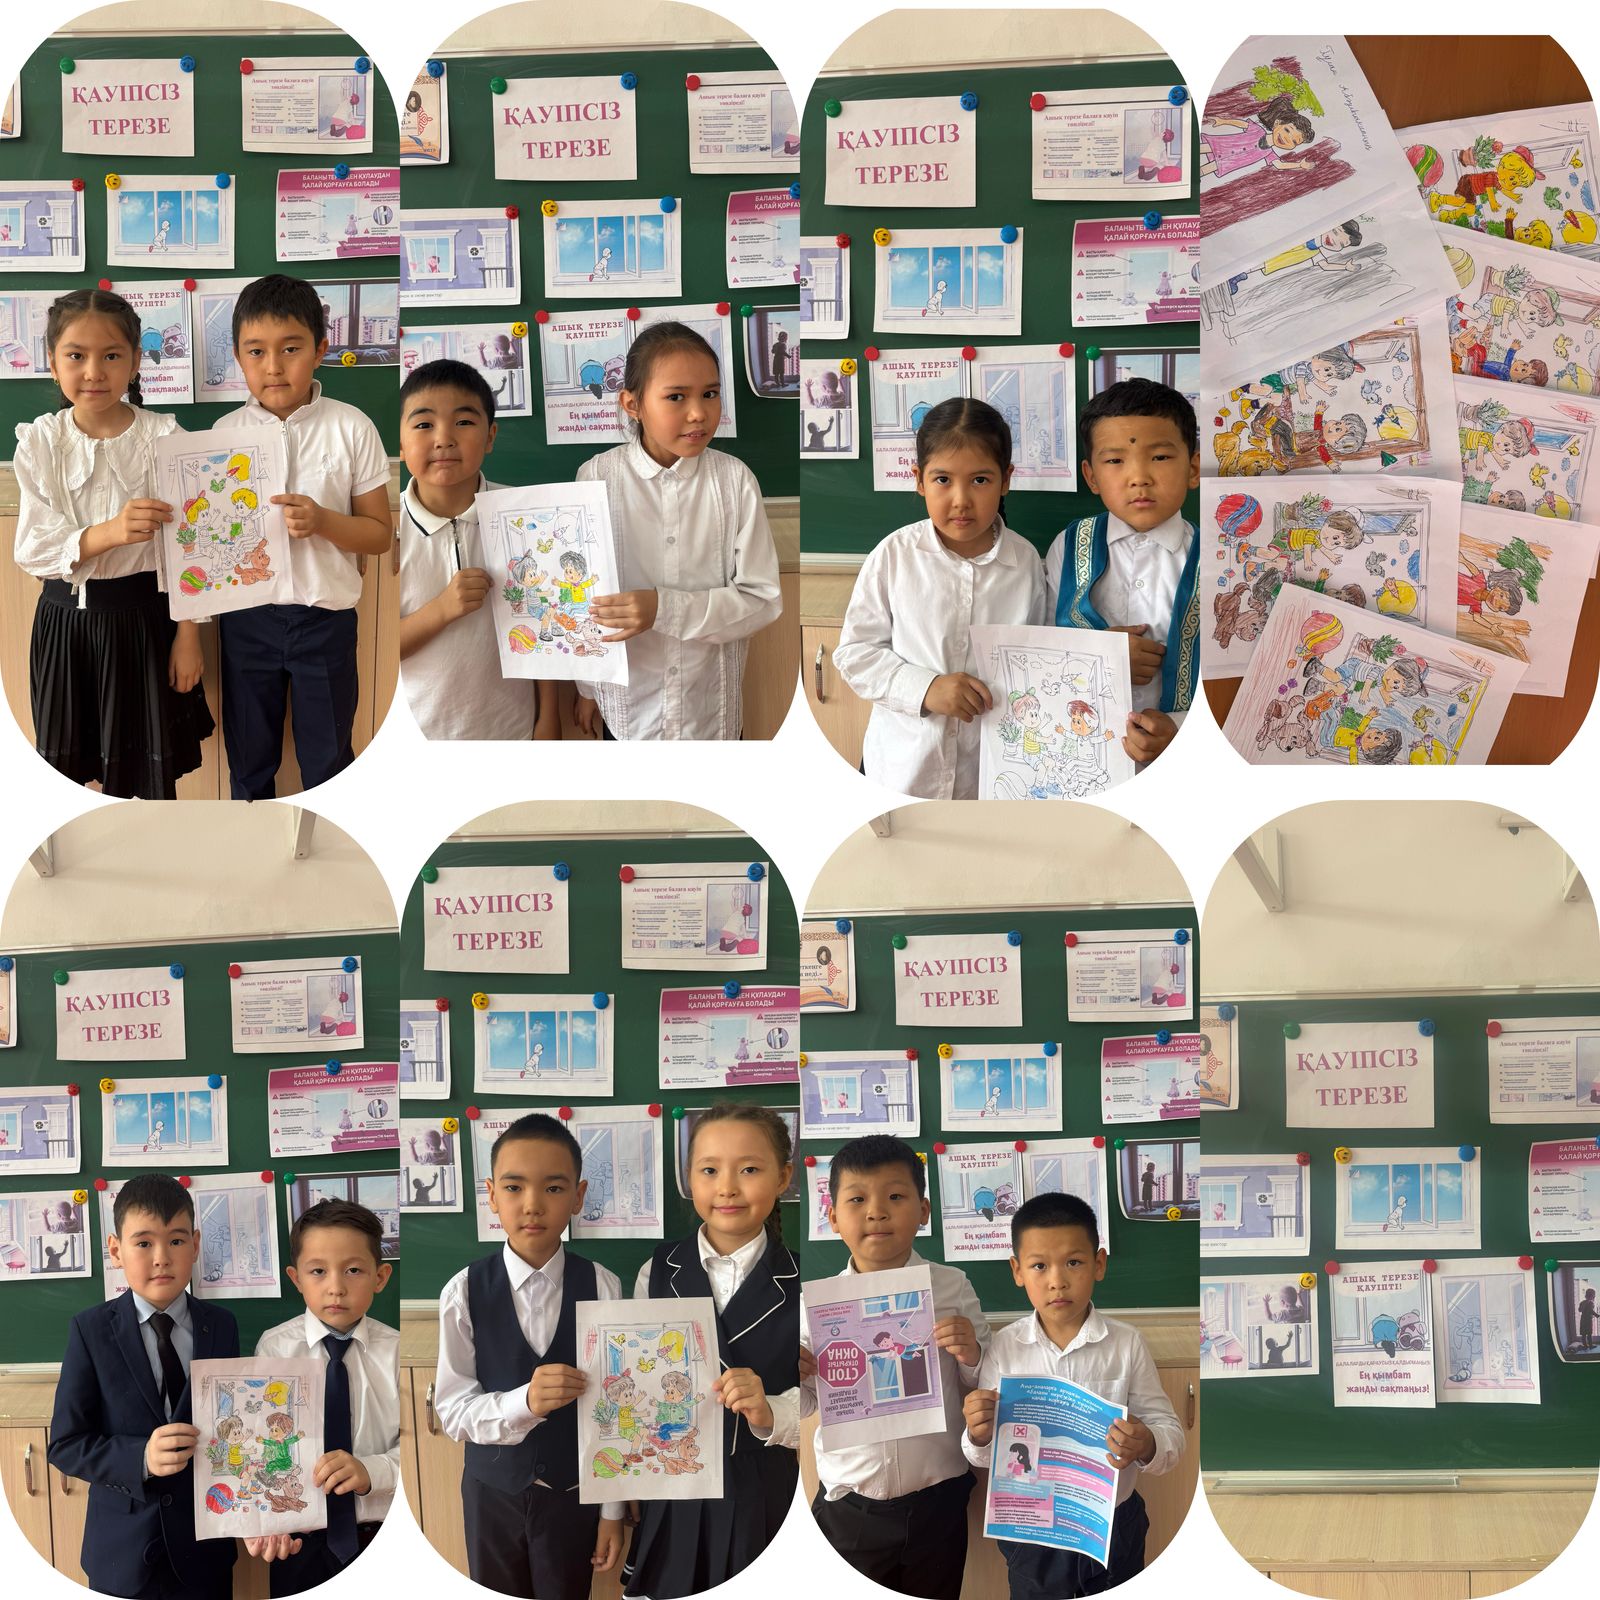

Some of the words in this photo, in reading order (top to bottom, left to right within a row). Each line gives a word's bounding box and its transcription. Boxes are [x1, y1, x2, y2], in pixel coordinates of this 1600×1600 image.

[71, 83, 180, 106] ҚАУІПСІЗ
[503, 101, 621, 128] ҚАУІПСІЗ
[88, 117, 171, 135] ТЕРЕЗЕ
[836, 123, 960, 152] ҚАУІПСІЗ
[522, 138, 612, 159] ТЕРЕЗЕ
[855, 162, 949, 185] ТЕРЕЗЕ
[755, 194, 782, 202] БАЛАНЫ
[754, 202, 777, 210] ҚАЛАЙ
[1104, 232, 1129, 241] ҚАЛАЙ
[1129, 231, 1166, 241] ҚОРҒАУҒА
[1167, 231, 1199, 240] БОЛАДЫ
[148, 291, 181, 299] ТЕРЕЗЕ
[552, 323, 583, 332] АШЫҚ
[588, 321, 624, 330] ТЕРЕЗЕ
[565, 330, 608, 340] ҚАУІПТІ!
[882, 363, 915, 371] АШЫҚ
[921, 361, 959, 369] ТЕРЕЗЕ
[141, 373, 174, 382] қымбат
[896, 371, 942, 380] ҚАУІПТІ!
[569, 411, 580, 420] Ең
[581, 409, 617, 419] қымбат
[558, 423, 587, 432] жанды
[898, 457, 909, 466] Ең
[433, 892, 554, 919] ҚАУІПСІЗ
[452, 931, 544, 951] ТЕРЕЗЕ
[904, 956, 1008, 980] ҚАУІПСІЗ
[65, 989, 171, 1015] ҚАУІПСІЗ
[920, 989, 1000, 1007] ТЕРЕЗЕ
[688, 1001, 710, 1009] ҚАЛАЙ
[746, 999, 775, 1007] БОЛАДЫ
[82, 1023, 162, 1042] ТЕРЕЗЕ
[1295, 1048, 1418, 1074] ҚАУІПСІЗ
[1315, 1085, 1408, 1106] ТЕРЕЗЕ
[1559, 1152, 1583, 1160] ҚАЛАЙ
[960, 1161, 999, 1169] ҚАУІПТІ!
[964, 1232, 974, 1240] Ең
[975, 1231, 1006, 1240] қымбат
[954, 1243, 980, 1252] жанды
[1342, 1275, 1376, 1284] АШЫҚ
[1382, 1273, 1420, 1282] ТЕРЕЗЕ
[1357, 1284, 1402, 1292] ҚАУІПТІ!
[827, 1348, 858, 1360] ОКНА
[828, 1360, 859, 1368] ОТКРЫТЫЕ
[827, 1367, 858, 1381] СТОП
[1359, 1370, 1371, 1380] Ең
[1372, 1369, 1411, 1379] қымбат
[1347, 1384, 1377, 1393] жанды
[1380, 1384, 1430, 1394] сақтаңыз!
